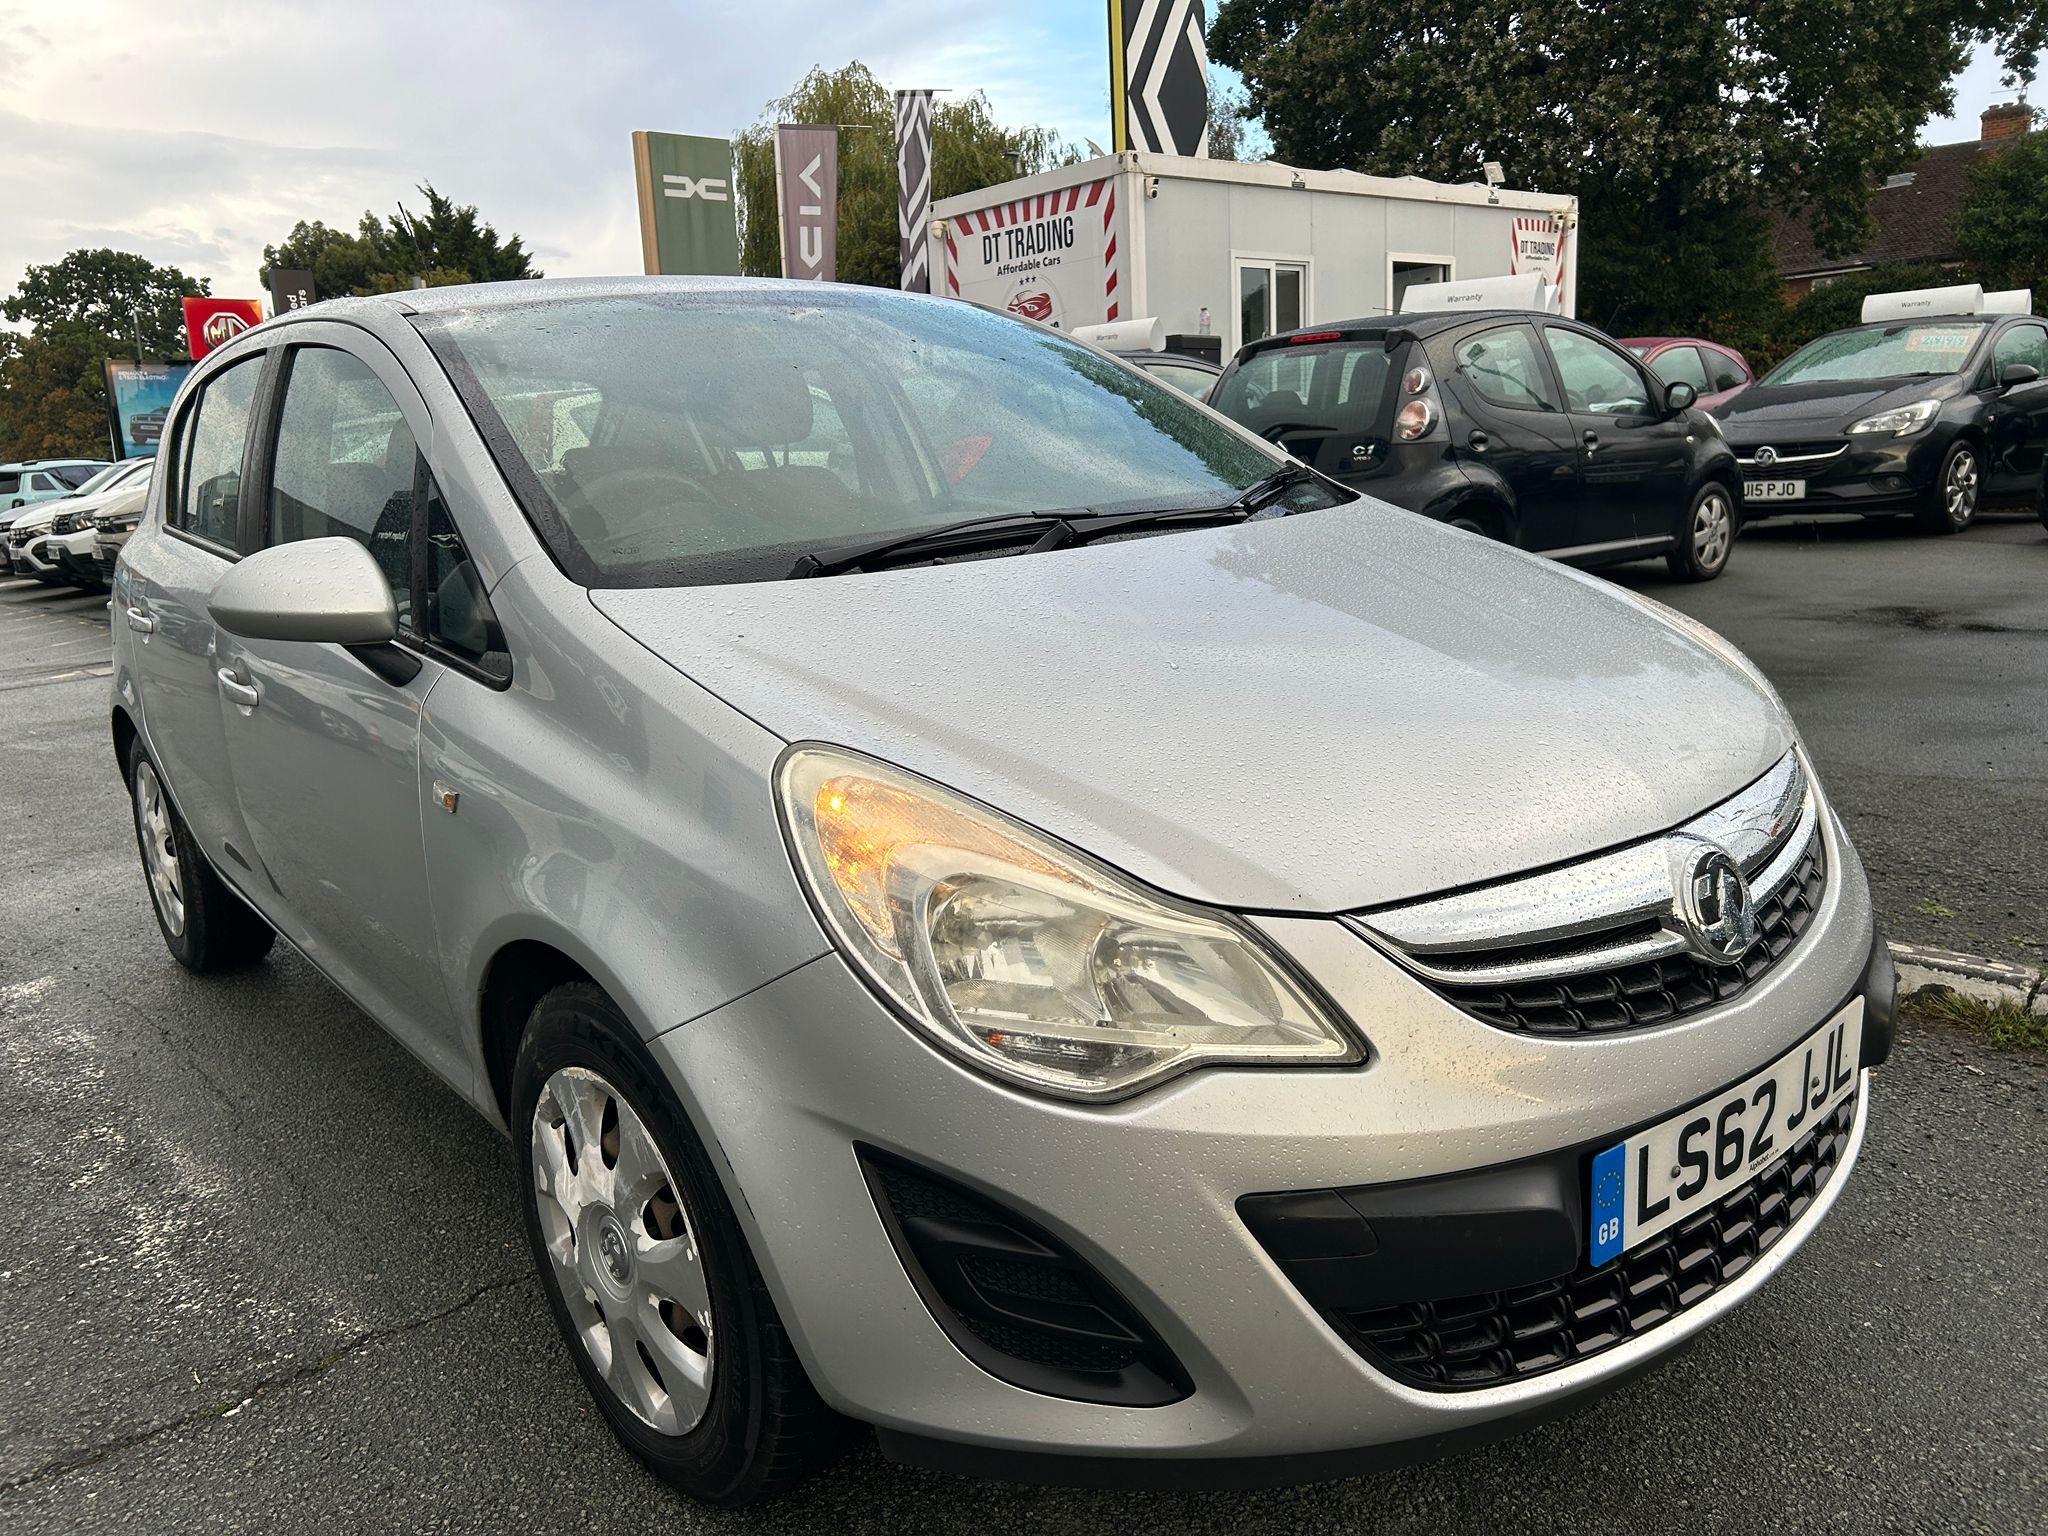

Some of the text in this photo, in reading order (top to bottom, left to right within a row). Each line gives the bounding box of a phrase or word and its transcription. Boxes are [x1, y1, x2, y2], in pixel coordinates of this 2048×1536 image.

[983, 215, 1074, 265] DT TRADING
[1521, 241, 1555, 255] DT TRADING
[996, 256, 1061, 277] Affordable Cars
[1447, 293, 1483, 304] Warranty
[1901, 300, 1931, 308] Warranty
[1352, 443, 1376, 456] C1
[1767, 482, 1795, 496] PJO
[1637, 1022, 1852, 1227] LS62 JJL
[1598, 1216, 1619, 1246] GB
